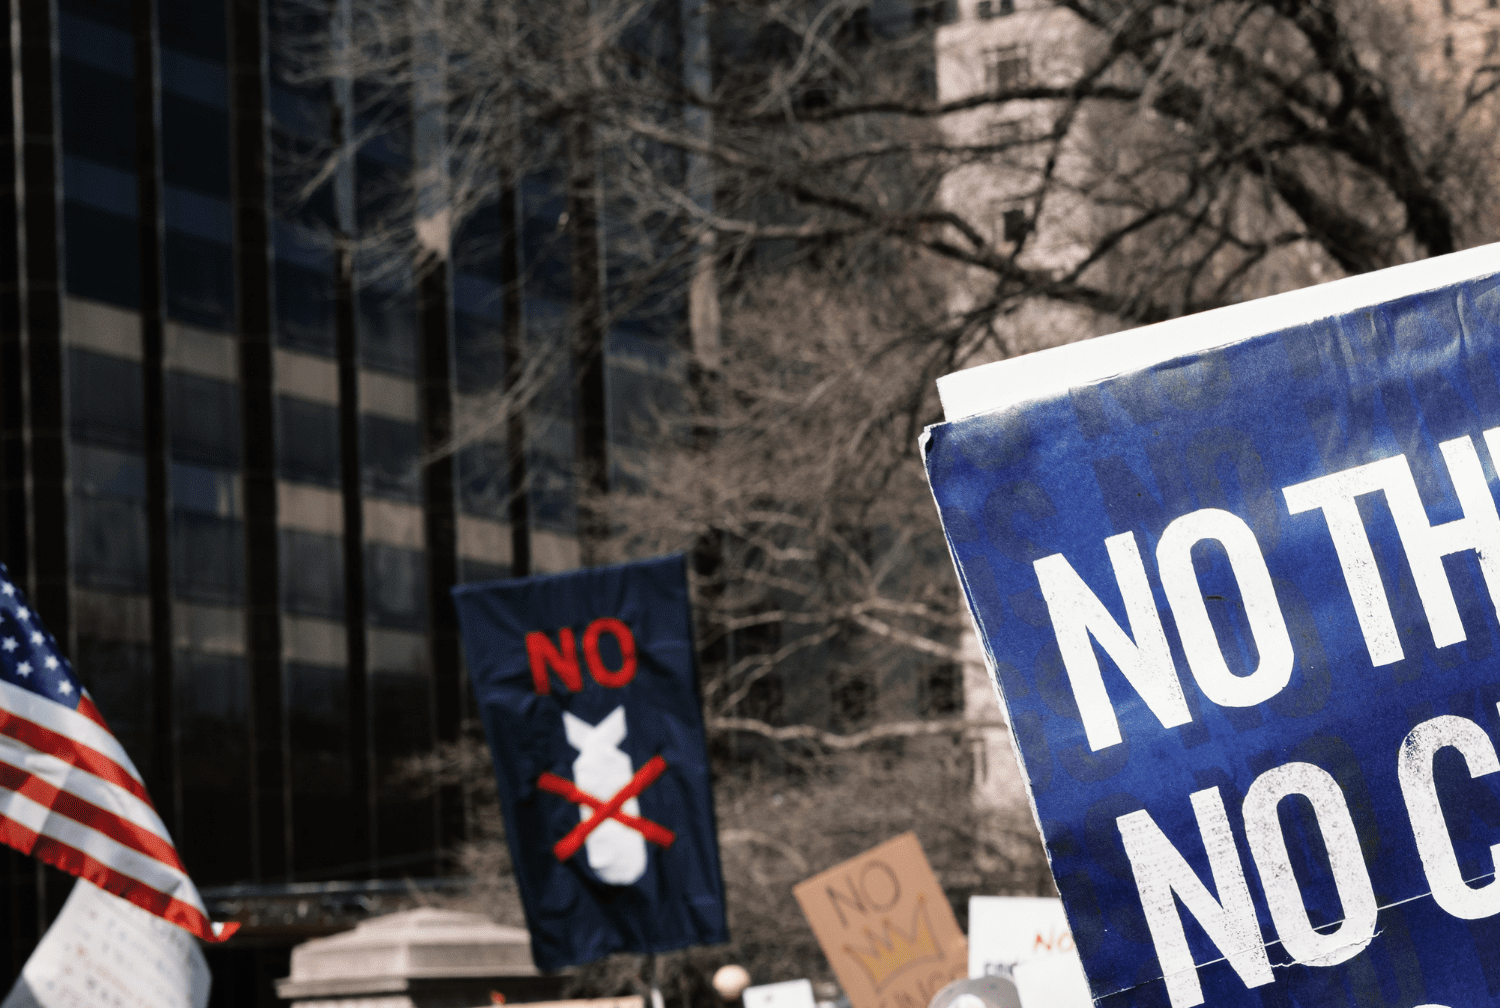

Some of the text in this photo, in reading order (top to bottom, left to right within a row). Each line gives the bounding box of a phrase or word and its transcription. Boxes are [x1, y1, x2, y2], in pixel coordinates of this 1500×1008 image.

[525, 617, 639, 697] NO
[1033, 508, 1294, 752] NO
[826, 859, 902, 928] NO
